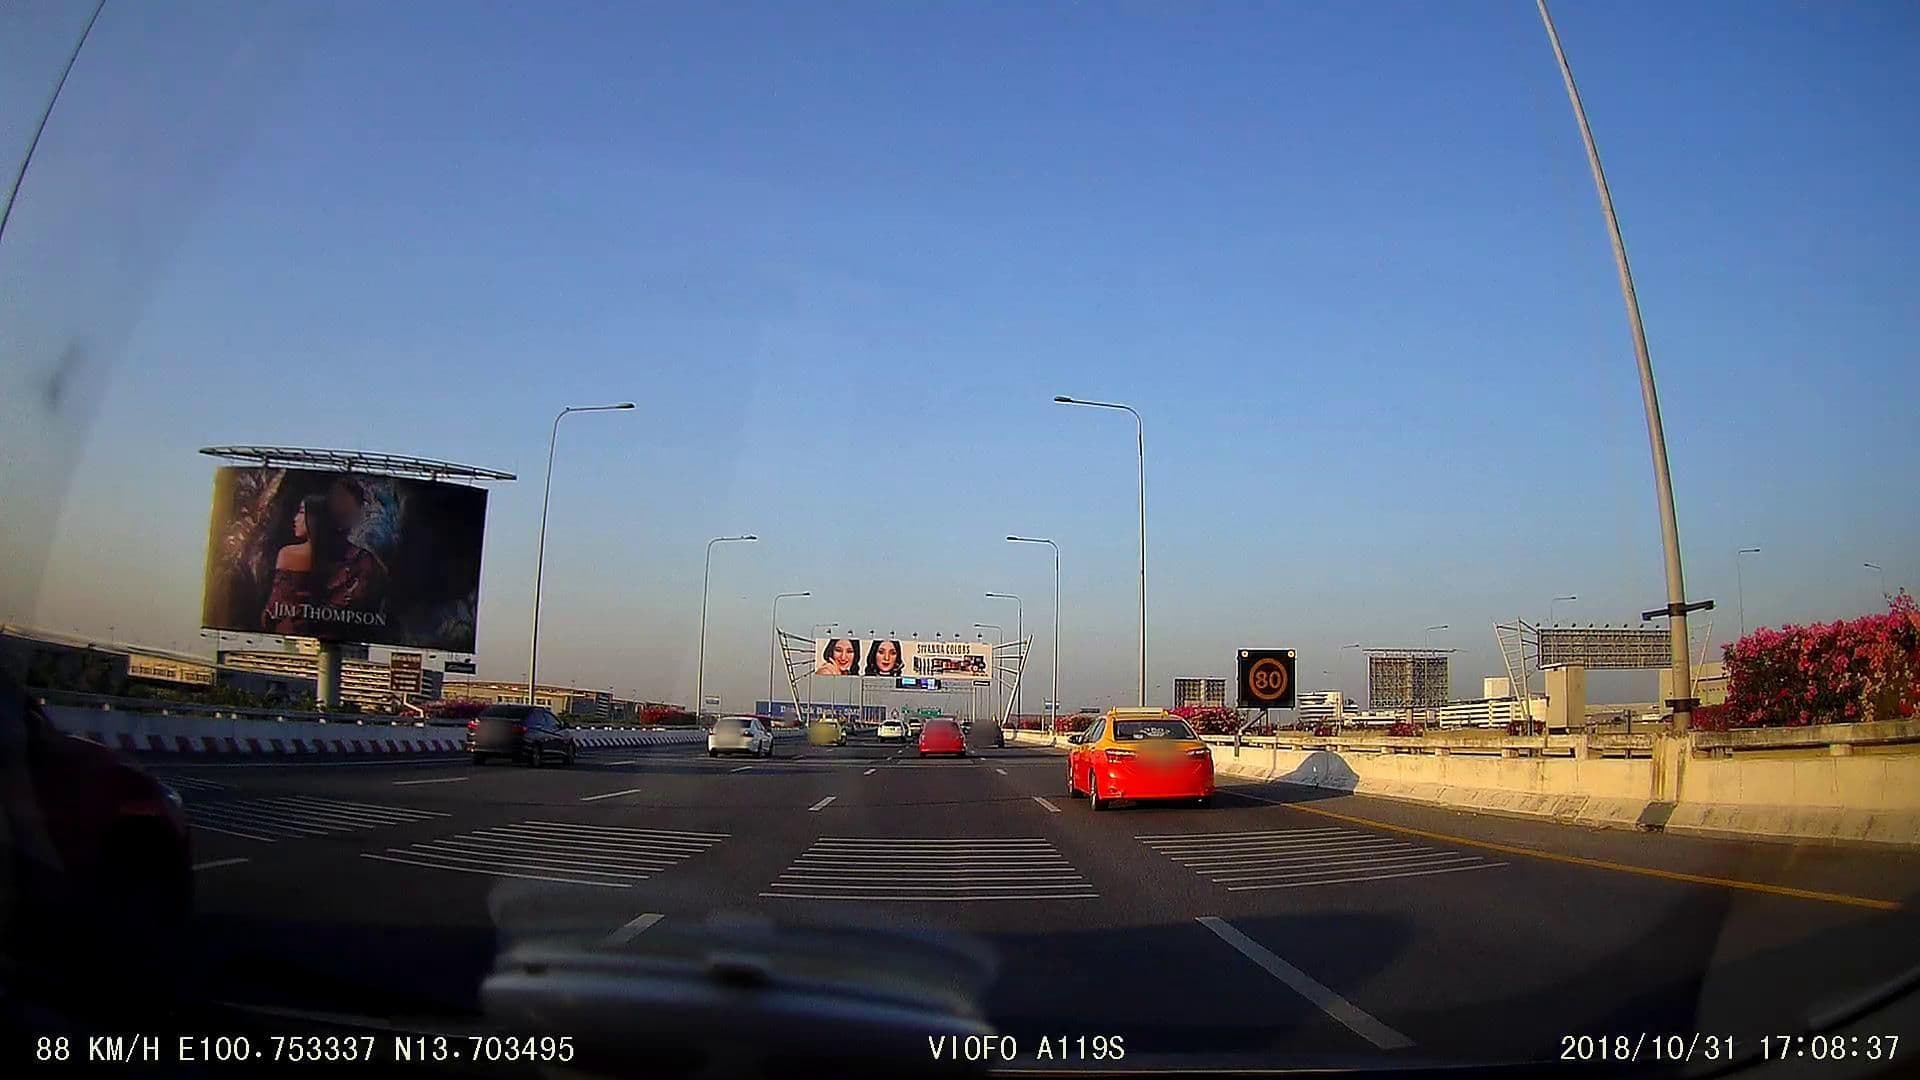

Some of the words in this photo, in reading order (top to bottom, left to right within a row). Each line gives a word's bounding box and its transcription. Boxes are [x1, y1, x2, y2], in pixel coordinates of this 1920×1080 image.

[271, 601, 296, 620] JIM
[299, 603, 386, 626] THOMPSON
[946, 644, 970, 655] COLORS
[1255, 670, 1281, 689] 80
